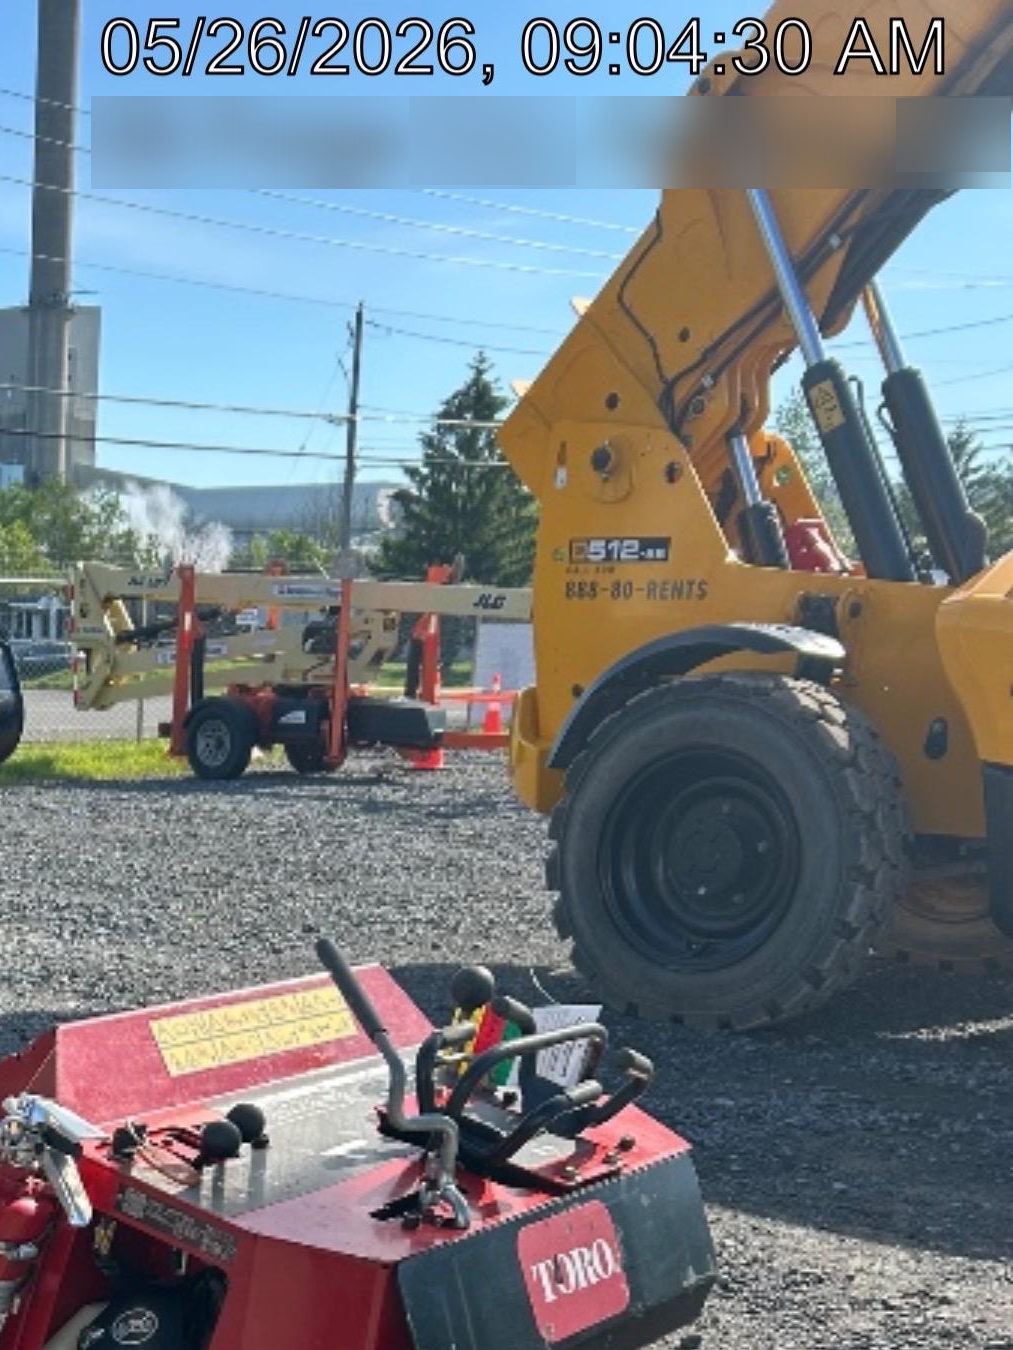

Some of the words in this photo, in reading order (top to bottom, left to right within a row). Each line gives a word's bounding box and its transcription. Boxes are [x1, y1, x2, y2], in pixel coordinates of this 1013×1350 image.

[565, 578, 709, 600] 888-80-RENTS
[473, 593, 507, 610] JLG
[530, 1237, 615, 1304] TORO
